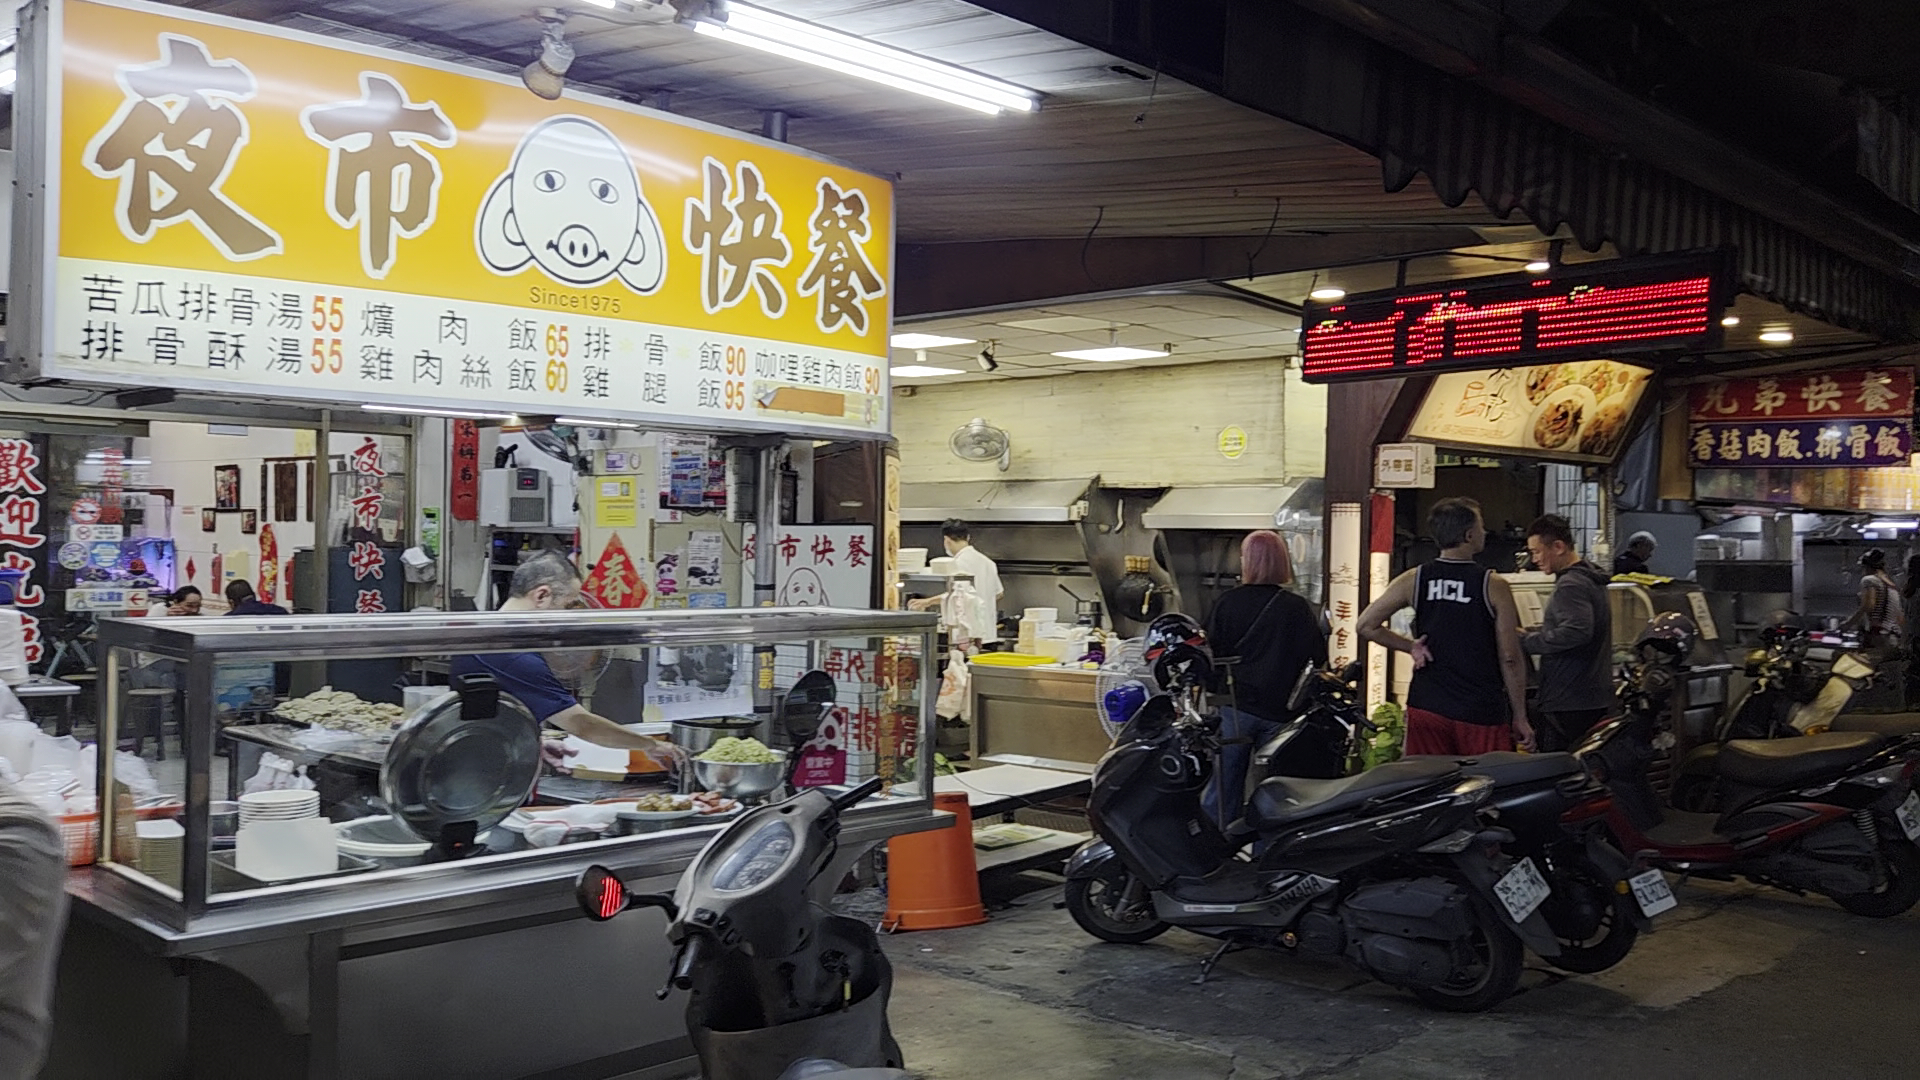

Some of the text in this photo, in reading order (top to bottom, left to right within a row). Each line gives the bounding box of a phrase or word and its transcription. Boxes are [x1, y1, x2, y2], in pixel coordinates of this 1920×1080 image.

[84, 33, 885, 336] 夜市 快餐
[82, 274, 302, 330] 苦瓜排骨湯
[312, 295, 344, 331] 55
[546, 324, 568, 357] 65
[584, 326, 722, 374] 排骨飯
[726, 345, 745, 376] 90
[756, 349, 861, 391] 咖哩雞肉飯
[864, 366, 879, 395] 90
[82, 320, 744, 410] 排骨酥湯 55 雞肉絲飯 60 雞腿飯 95
[1700, 372, 1899, 415] 兄弟快餐
[600, 552, 632, 607] 春
[1426, 579, 1472, 604] HCL
